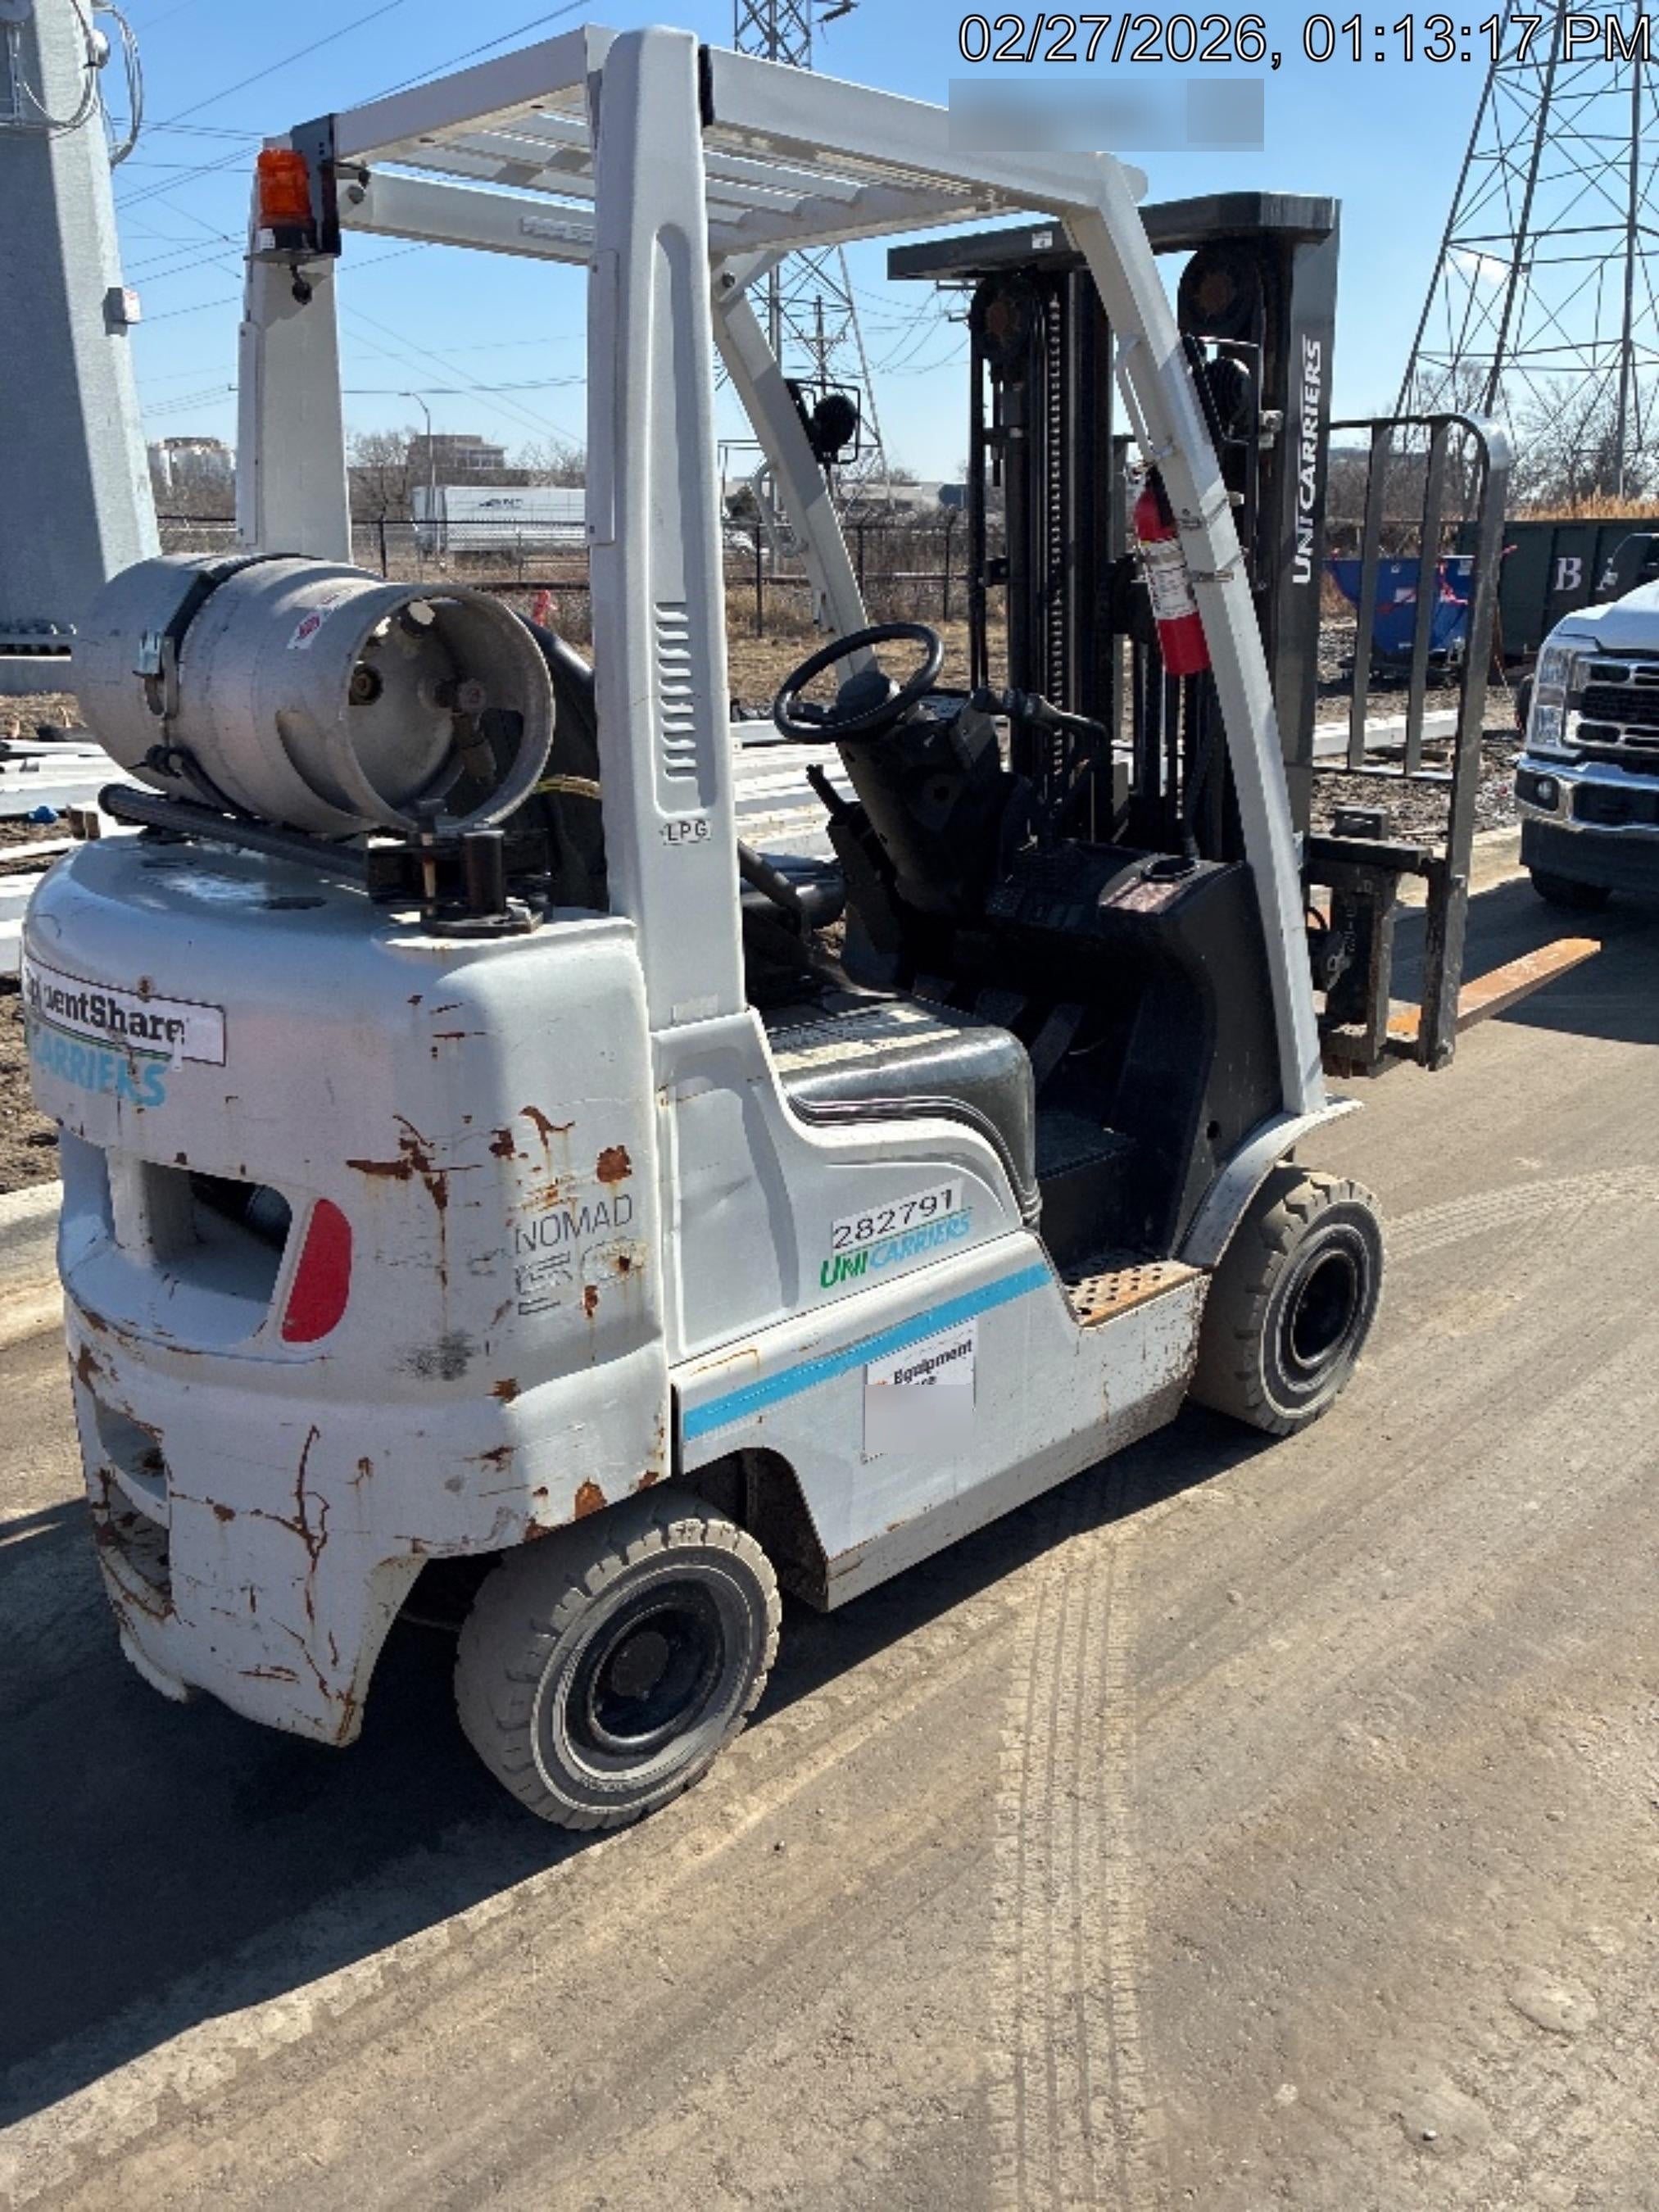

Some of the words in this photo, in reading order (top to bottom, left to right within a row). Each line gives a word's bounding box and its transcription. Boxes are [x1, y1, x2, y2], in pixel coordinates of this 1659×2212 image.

[667, 818, 708, 841] LPG
[515, 1194, 632, 1254] NOMAD
[832, 1189, 953, 1249] 282791
[893, 1339, 973, 1385] Equipment
